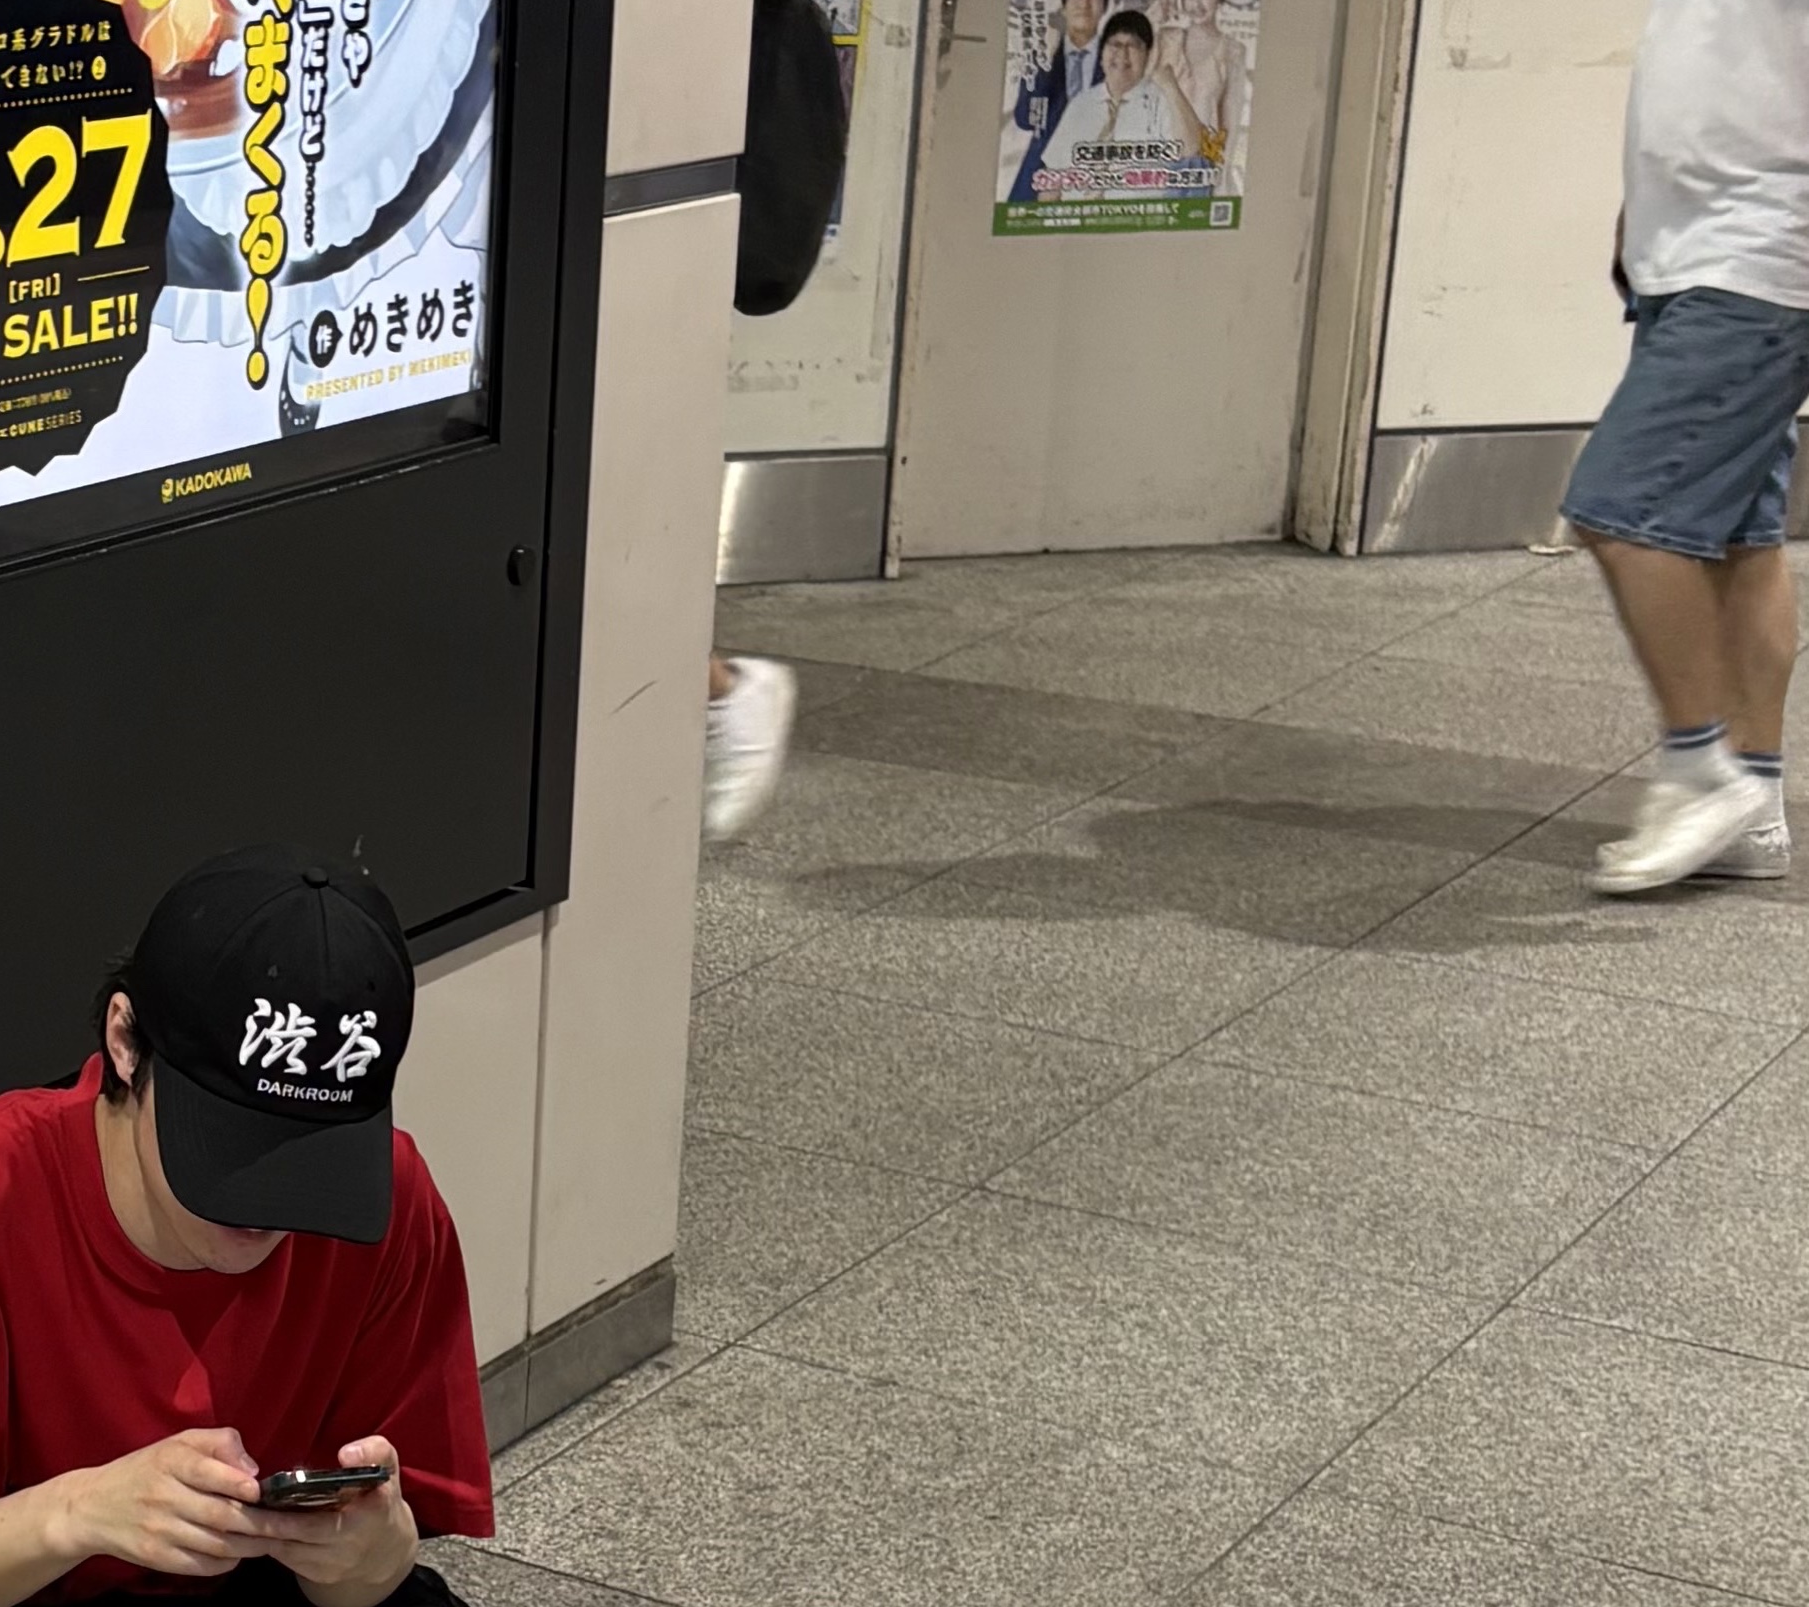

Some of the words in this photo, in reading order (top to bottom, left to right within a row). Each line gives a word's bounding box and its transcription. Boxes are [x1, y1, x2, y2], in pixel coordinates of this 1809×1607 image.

[3, 292, 139, 359] SALE!!
[348, 278, 476, 359] めきめき
[306, 368, 384, 402] PRESENTED
[388, 362, 405, 383] BY
[408, 348, 471, 378] MEKIMEKI
[175, 462, 253, 498] KADOKAWA
[238, 997, 383, 1084] 渋谷
[256, 1078, 355, 1104] DARKROOM
